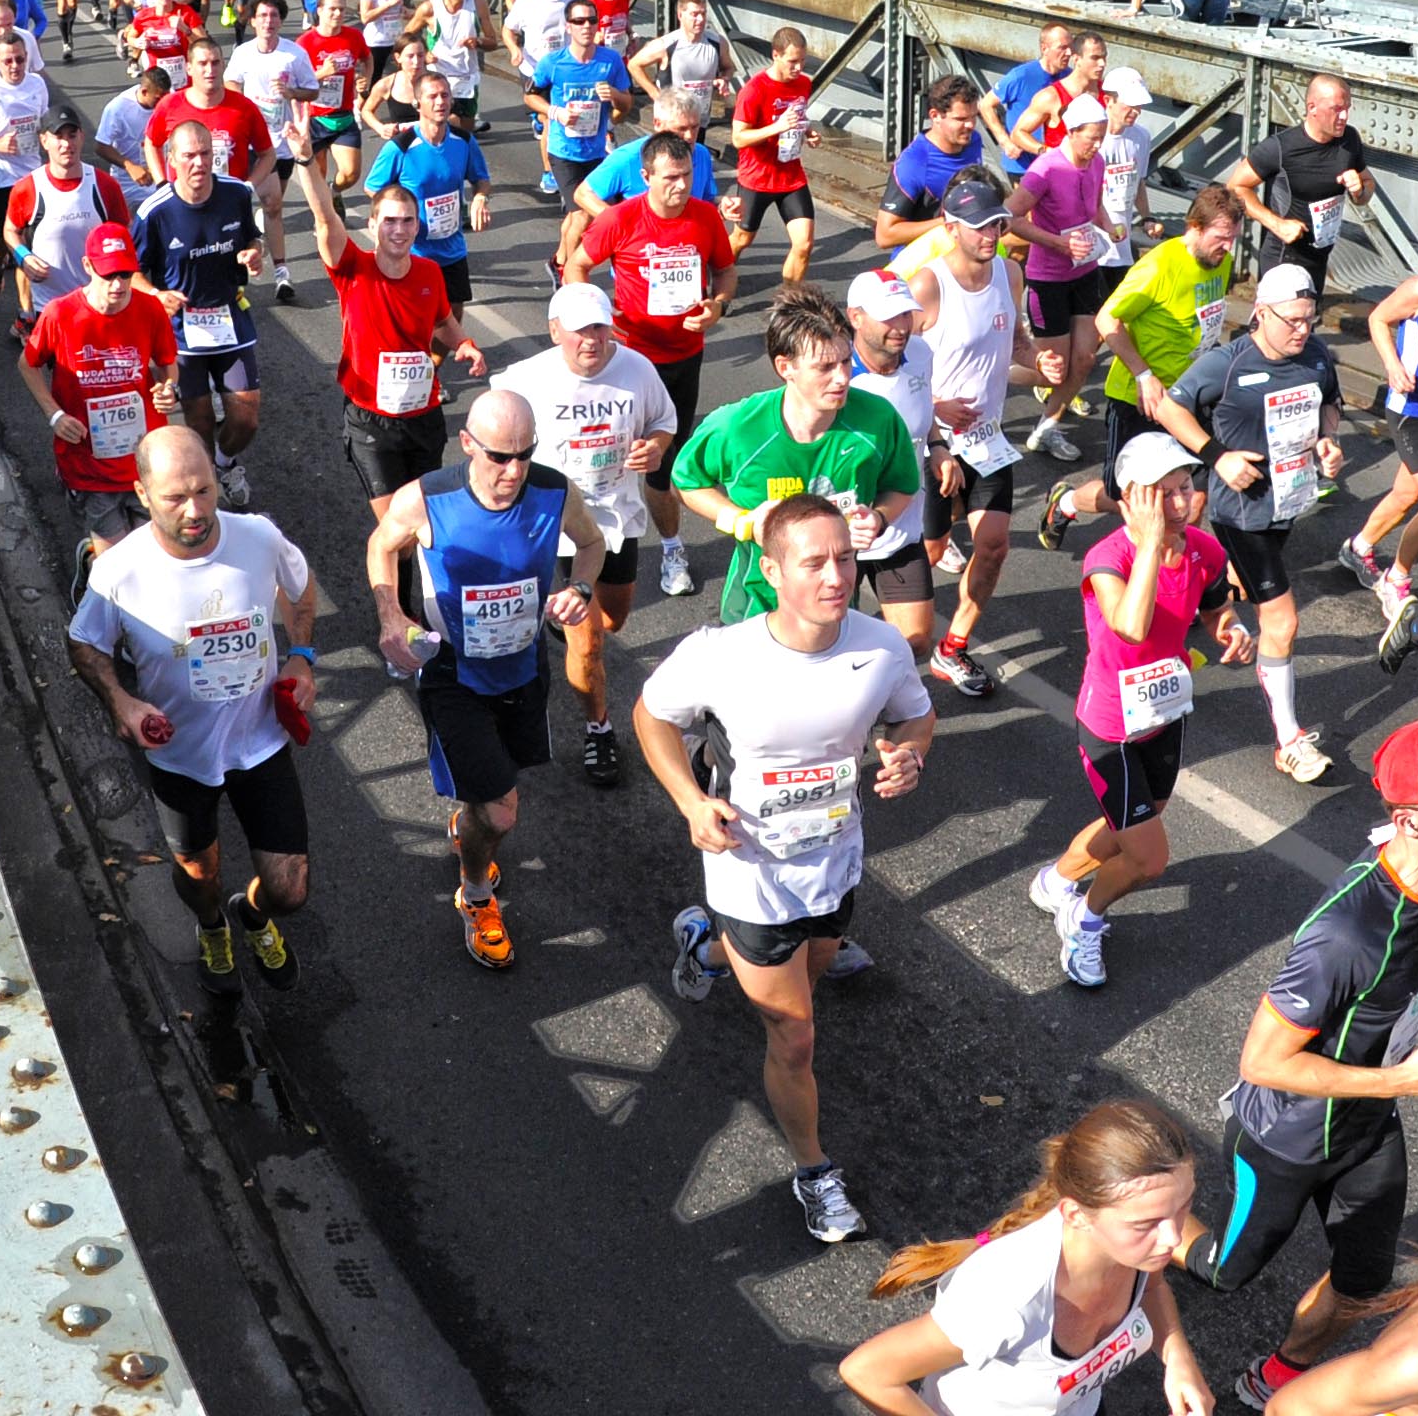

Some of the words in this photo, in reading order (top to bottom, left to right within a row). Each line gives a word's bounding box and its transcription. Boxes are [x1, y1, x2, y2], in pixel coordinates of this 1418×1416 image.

[433, 201, 455, 217] 2637
[190, 239, 235, 260] Finisher
[661, 260, 690, 269] SPAR
[660, 270, 694, 284] 3406
[192, 314, 224, 327] 3427
[392, 366, 425, 381] 1507
[1276, 390, 1309, 405] SPAR
[100, 407, 137, 425] 1766
[556, 399, 634, 420] ZRÍNYI
[579, 437, 616, 448] SPAR
[963, 422, 994, 449] 3280
[475, 587, 520, 600] SPAR
[477, 599, 526, 620] 4812
[202, 619, 250, 636] SPAR
[203, 631, 259, 657] 2530
[1132, 663, 1175, 683] SPAR
[1138, 675, 1181, 703] 5088
[775, 766, 834, 784] SPAR
[777, 781, 837, 808] 3951
[1074, 1334, 1130, 1384] SPAR
